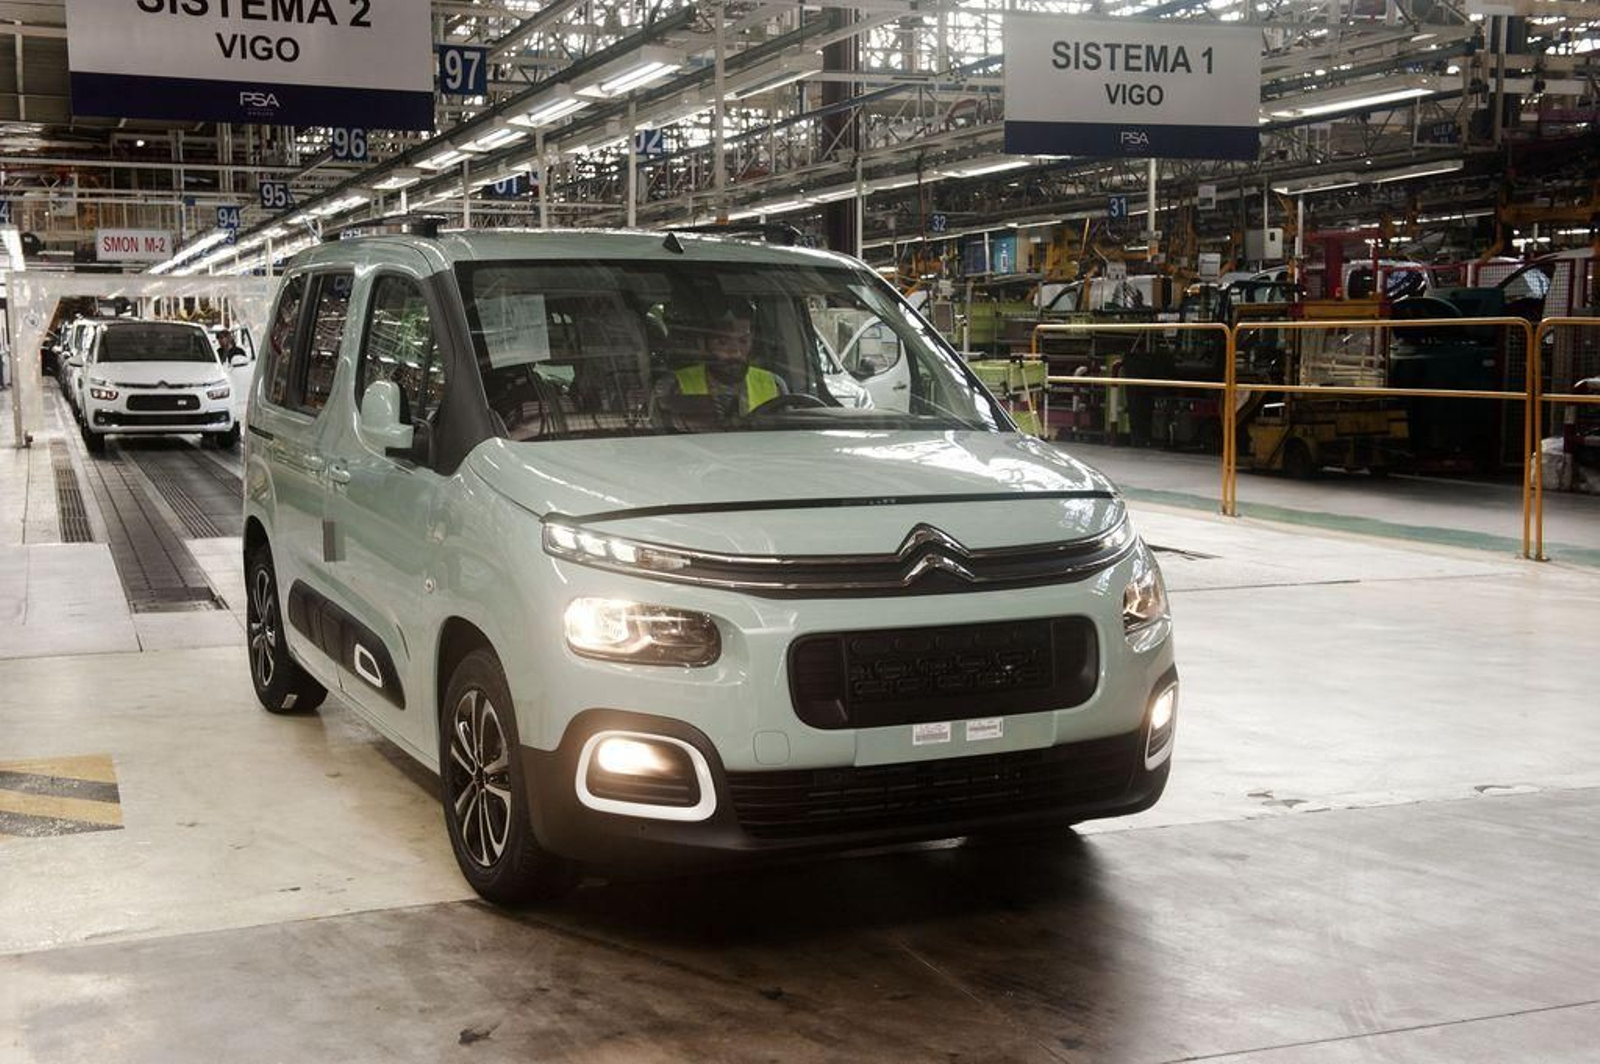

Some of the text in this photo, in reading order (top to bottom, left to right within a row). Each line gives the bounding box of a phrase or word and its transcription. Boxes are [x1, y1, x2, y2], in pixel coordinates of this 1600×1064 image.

[349, 0, 372, 28] 2
[215, 32, 300, 63] VIGO
[1051, 40, 1215, 75] SISTEMA 1
[444, 49, 482, 90] 97
[239, 91, 280, 108] PSA
[1105, 83, 1165, 106] VIGO
[333, 127, 366, 158] 96
[1120, 131, 1149, 145] PSA
[262, 183, 287, 207] 95
[218, 208, 239, 228] 94
[1110, 197, 1127, 218] 31
[932, 214, 947, 232] 32
[103, 236, 166, 252] SMON M-2
